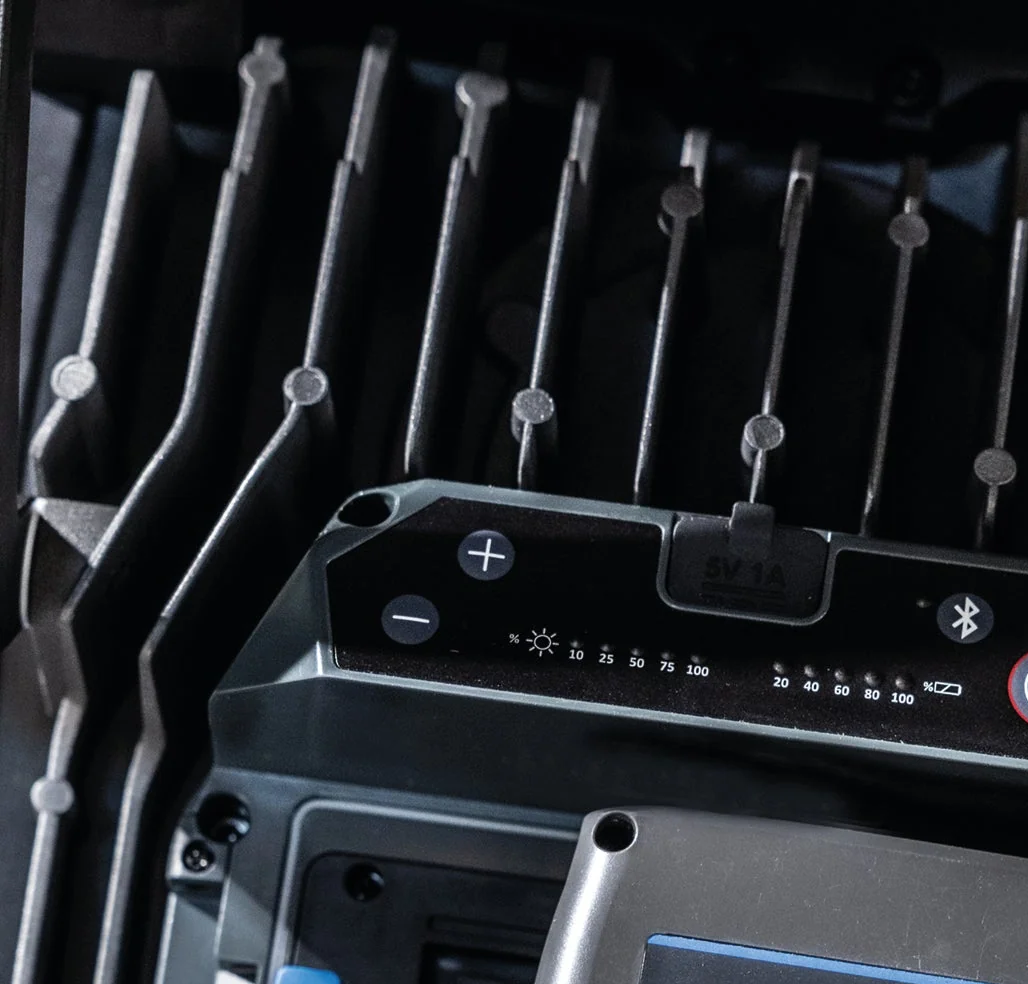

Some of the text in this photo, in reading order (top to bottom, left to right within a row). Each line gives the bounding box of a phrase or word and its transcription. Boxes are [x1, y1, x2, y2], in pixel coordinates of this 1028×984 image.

[568, 649, 585, 661] 10
[598, 653, 615, 665] 25
[629, 657, 645, 669] 50
[659, 661, 676, 673] 75
[686, 665, 710, 677] 100
[773, 676, 790, 689] 20
[803, 680, 820, 693] 40
[834, 684, 851, 697] 60
[864, 688, 881, 701] 80
[890, 692, 915, 705] 100
